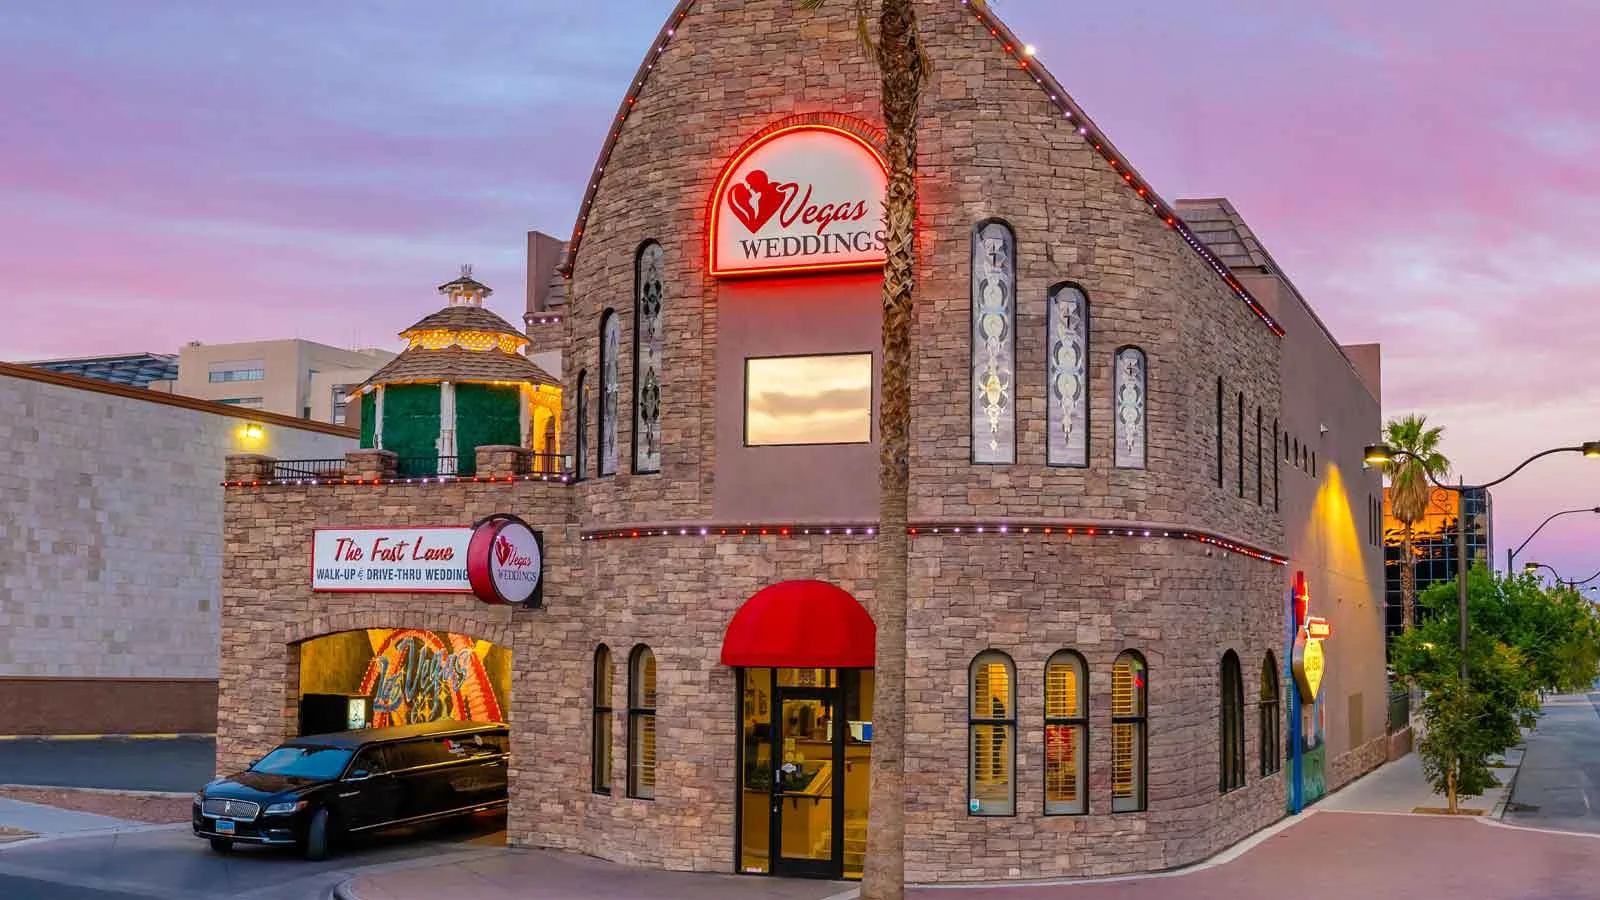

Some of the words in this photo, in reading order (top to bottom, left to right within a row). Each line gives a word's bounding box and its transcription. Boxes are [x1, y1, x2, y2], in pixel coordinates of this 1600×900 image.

[777, 183, 868, 235] Vegas
[739, 230, 887, 260] WEDDINGS
[335, 537, 363, 561] The
[370, 537, 410, 561] Fast
[413, 536, 454, 561] Lane
[508, 544, 532, 570] Vegas
[317, 567, 356, 581] WALK-UP
[367, 567, 422, 581] DRIVE-THRU
[425, 567, 469, 581] WEDDING
[397, 636, 472, 724] Vegas
